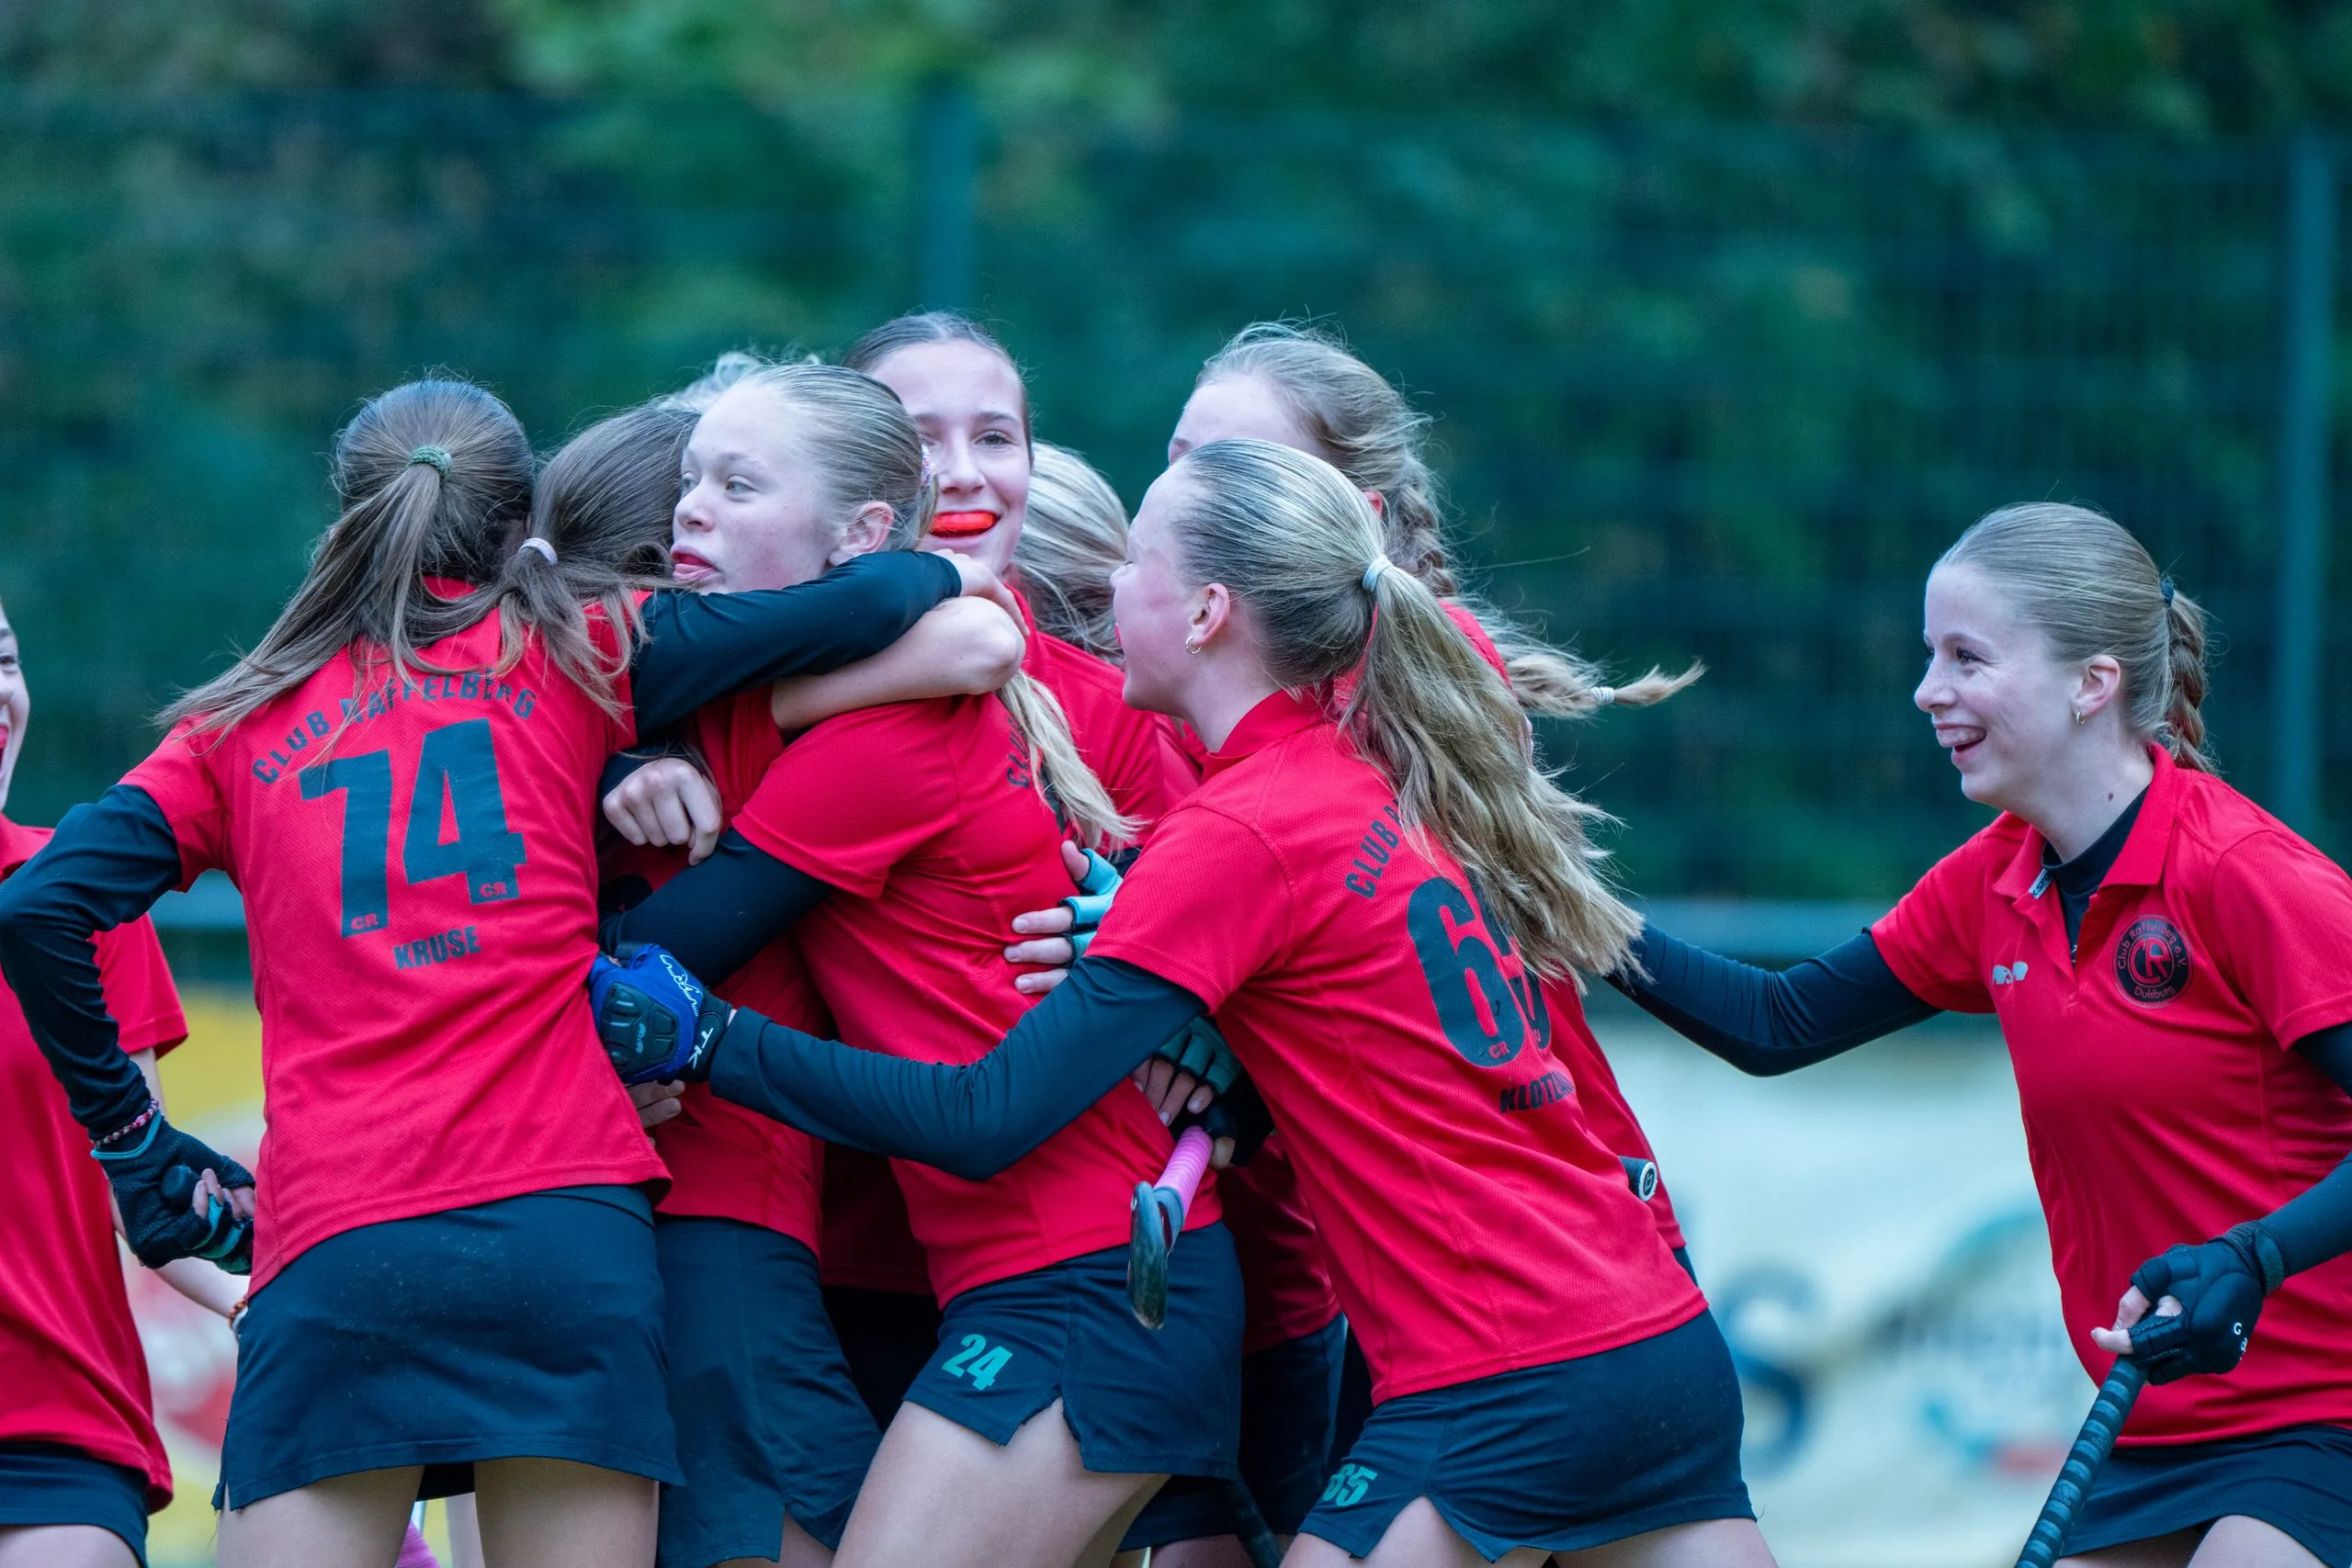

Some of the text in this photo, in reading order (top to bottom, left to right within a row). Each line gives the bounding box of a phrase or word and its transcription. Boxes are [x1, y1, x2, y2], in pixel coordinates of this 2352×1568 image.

[252, 668, 537, 784] CLUB RAFFELBERG
[299, 718, 527, 939] 74
[1344, 820, 1399, 898] CLUB
[478, 882, 507, 897] CR
[351, 913, 379, 930] CR
[393, 925, 482, 969] KRUSE
[2118, 940, 2131, 970] Club
[2134, 986, 2176, 999] Duisburg
[1488, 1041, 1510, 1059] CR
[941, 1333, 1013, 1391] 24
[1322, 1462, 1378, 1506] 65
